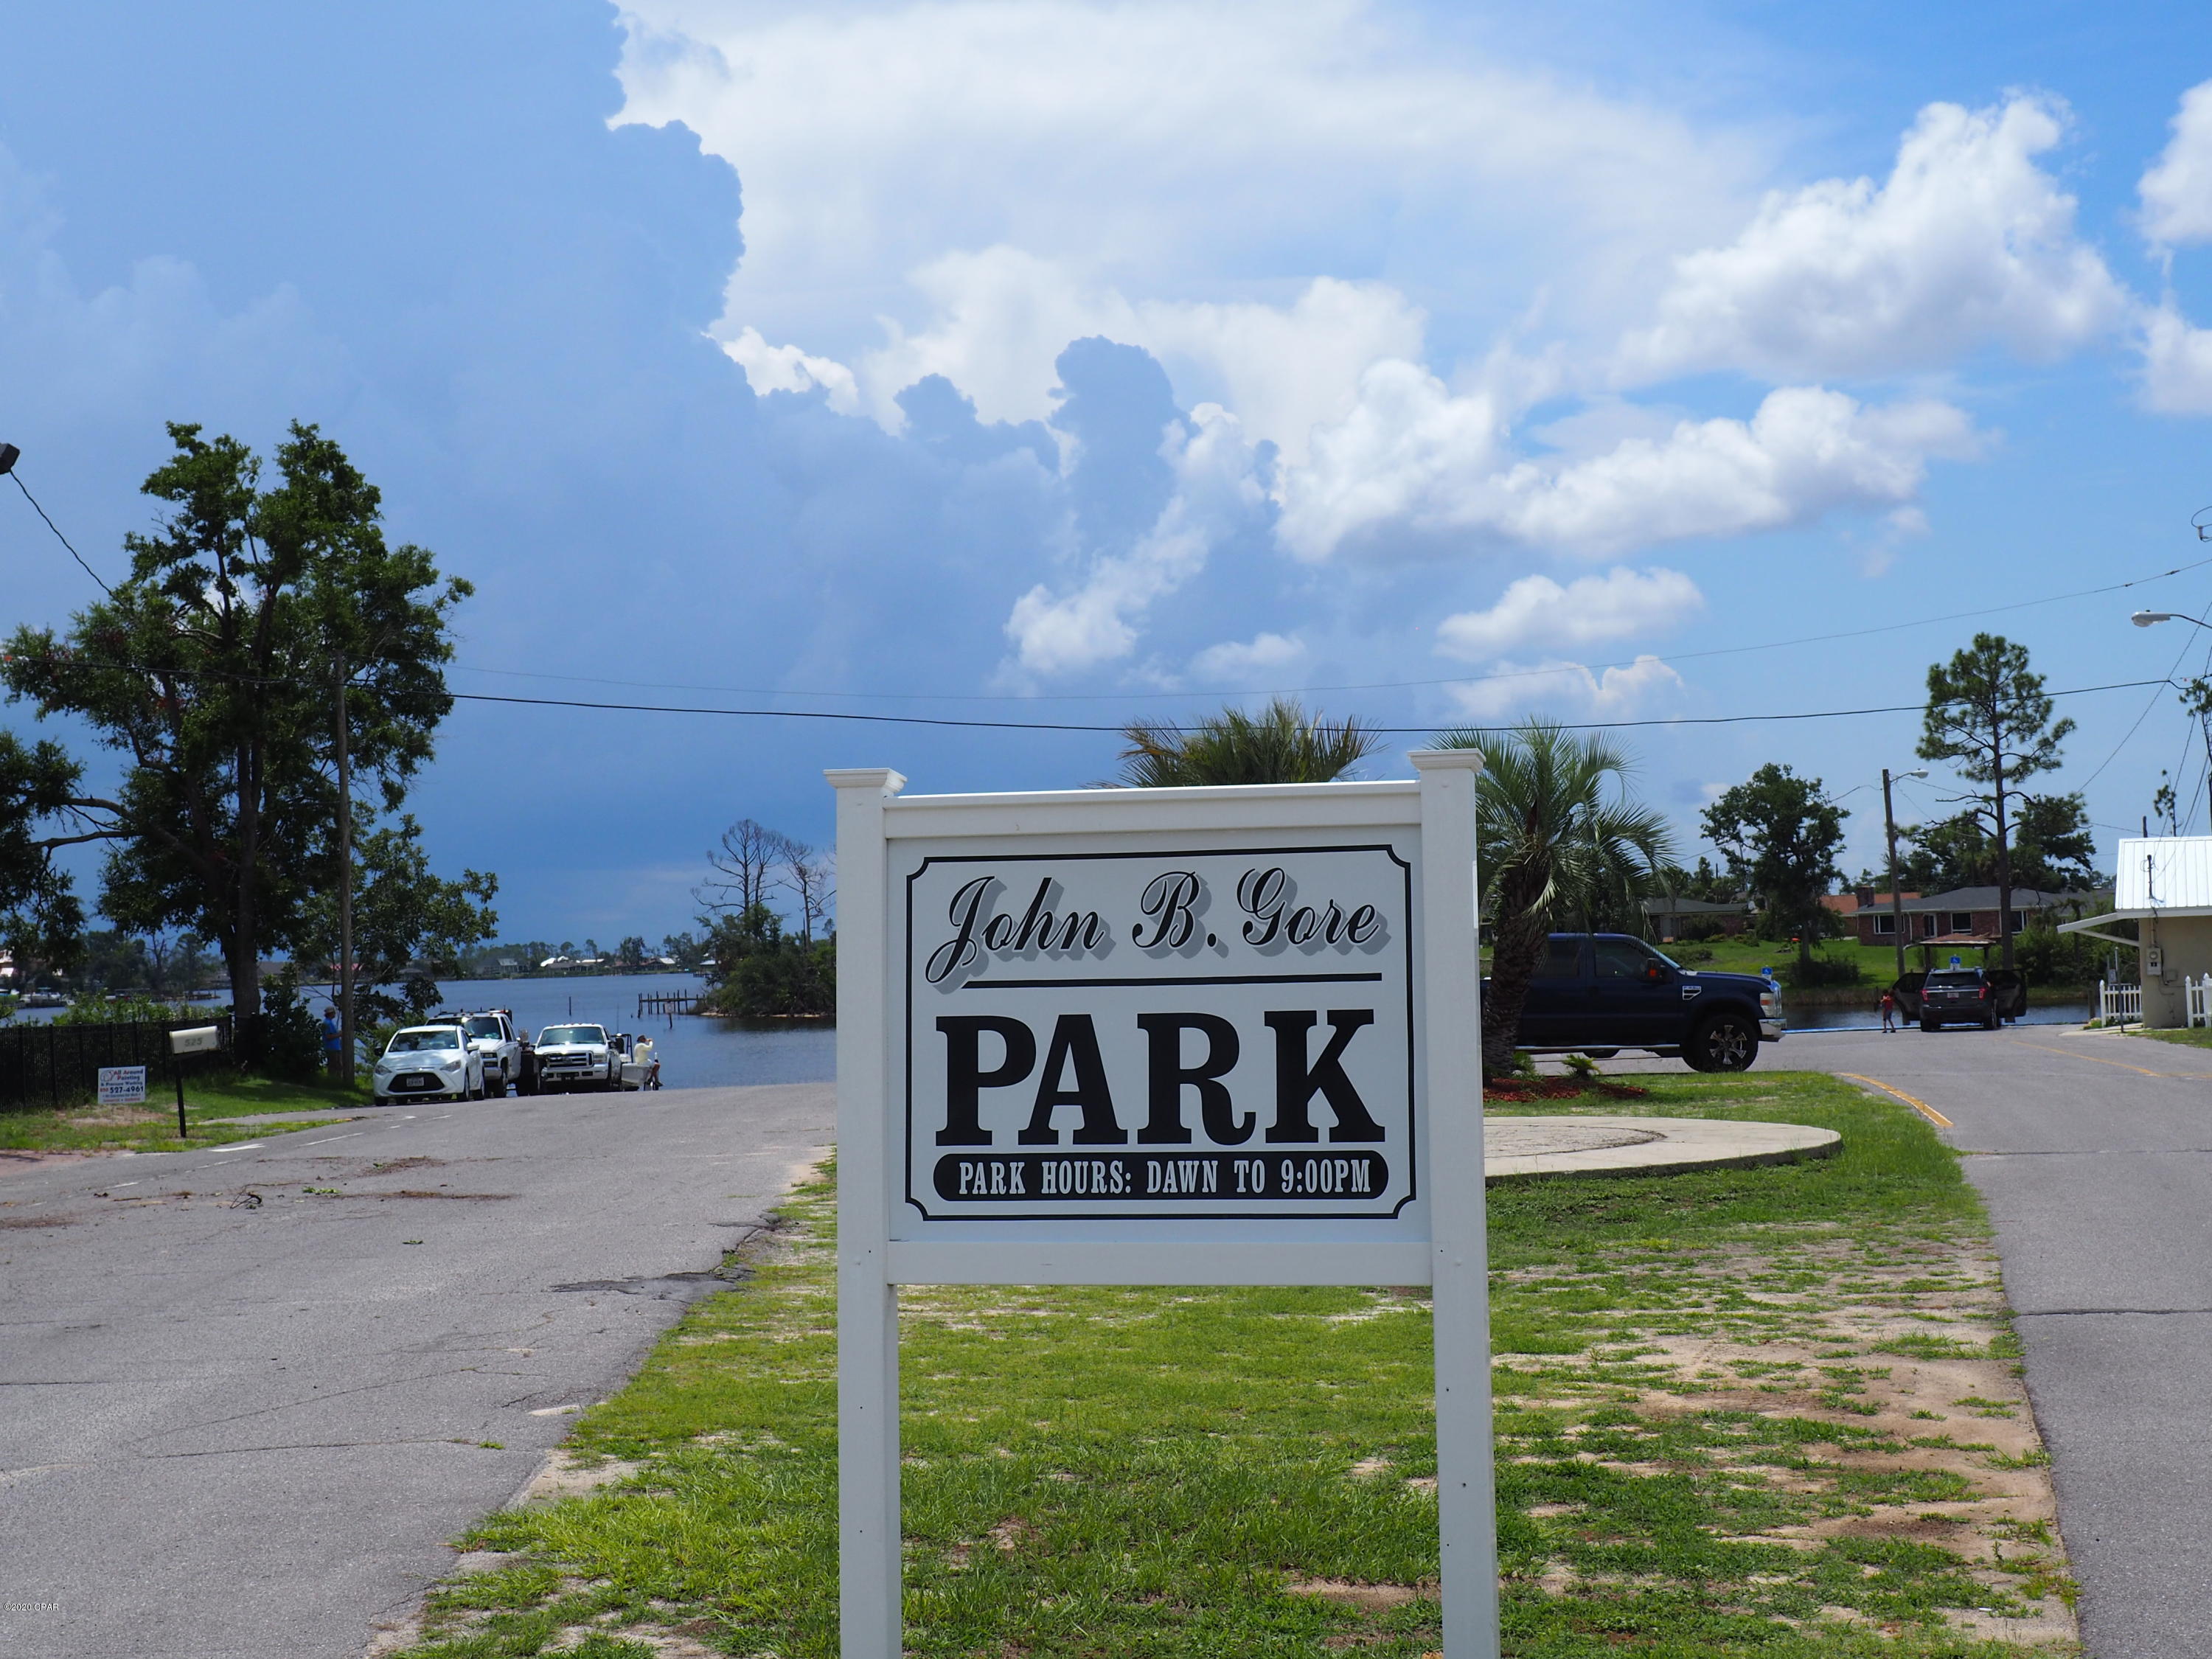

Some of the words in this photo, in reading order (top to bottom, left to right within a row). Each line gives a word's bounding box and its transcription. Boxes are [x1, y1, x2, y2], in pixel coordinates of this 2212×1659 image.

[925, 875, 1105, 984] John
[1132, 871, 1217, 948] B.
[1237, 867, 1380, 946] Gore
[935, 1009, 1385, 1147] PARK
[959, 1161, 1026, 1195] PARK
[1041, 1161, 1132, 1194] HOURS:
[1147, 1160, 1218, 1194] DAWN
[1234, 1160, 1265, 1193] TO
[1281, 1158, 1371, 1193] 9:00PM
